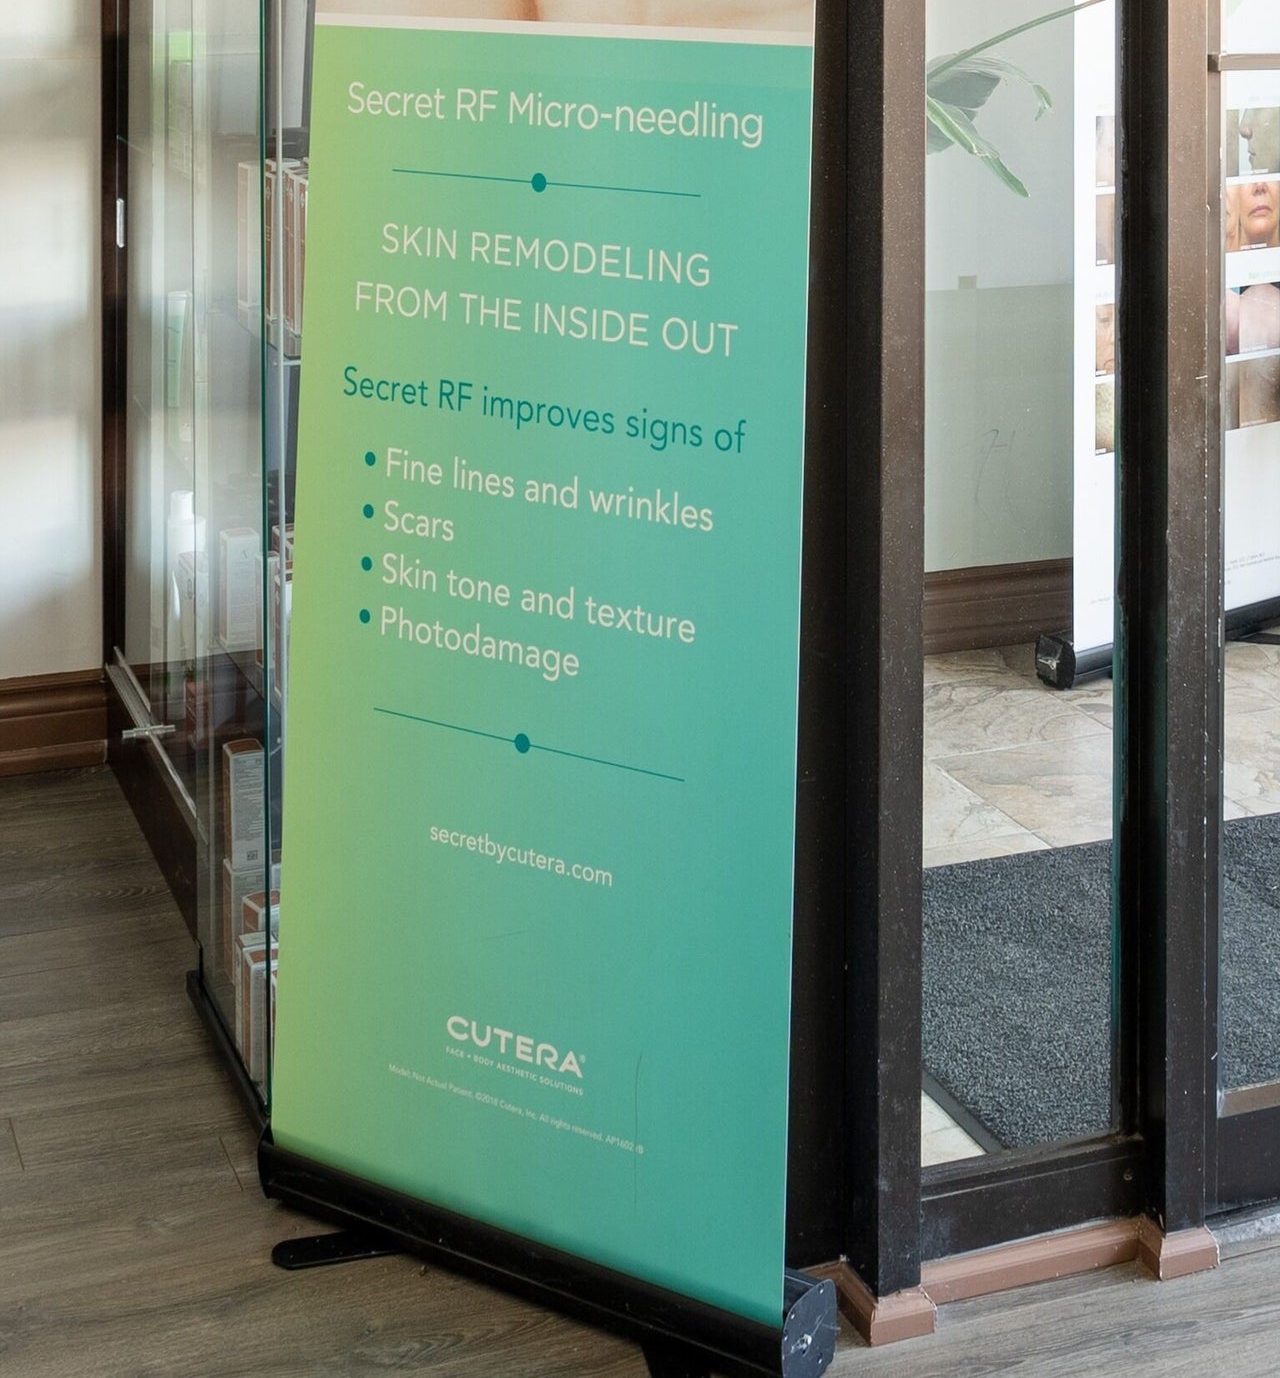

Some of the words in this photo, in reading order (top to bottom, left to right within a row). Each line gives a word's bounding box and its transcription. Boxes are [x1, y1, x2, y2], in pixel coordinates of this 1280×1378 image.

[347, 81, 444, 119] Secret
[456, 87, 498, 122] RF
[508, 91, 764, 149] Micro-needling
[382, 223, 458, 261] SKIN
[470, 230, 711, 288] REMODELING
[355, 281, 448, 322] FROM
[458, 292, 522, 331] THE
[533, 302, 650, 347] INSIDE
[662, 316, 739, 358] OUT
[342, 365, 429, 409] Secret
[438, 378, 473, 413] RF
[482, 386, 615, 435] improves
[626, 407, 703, 451] signs
[713, 419, 747, 454] of
[383, 499, 455, 543] Scars
[385, 447, 443, 485] Fine
[453, 456, 515, 499] lines
[524, 476, 579, 510] and
[589, 486, 714, 532] wrinkles
[382, 552, 438, 593] Skin
[446, 568, 511, 607] tone
[520, 586, 575, 621] and
[585, 594, 696, 644] texture
[381, 605, 580, 681] Photodamage
[430, 823, 614, 888] secretbycutera.com
[446, 1046, 465, 1060] FACE
[473, 1054, 494, 1067] BODY
[496, 1062, 538, 1082] AESTHETIC
[539, 1076, 584, 1096] SOLUTIONS
